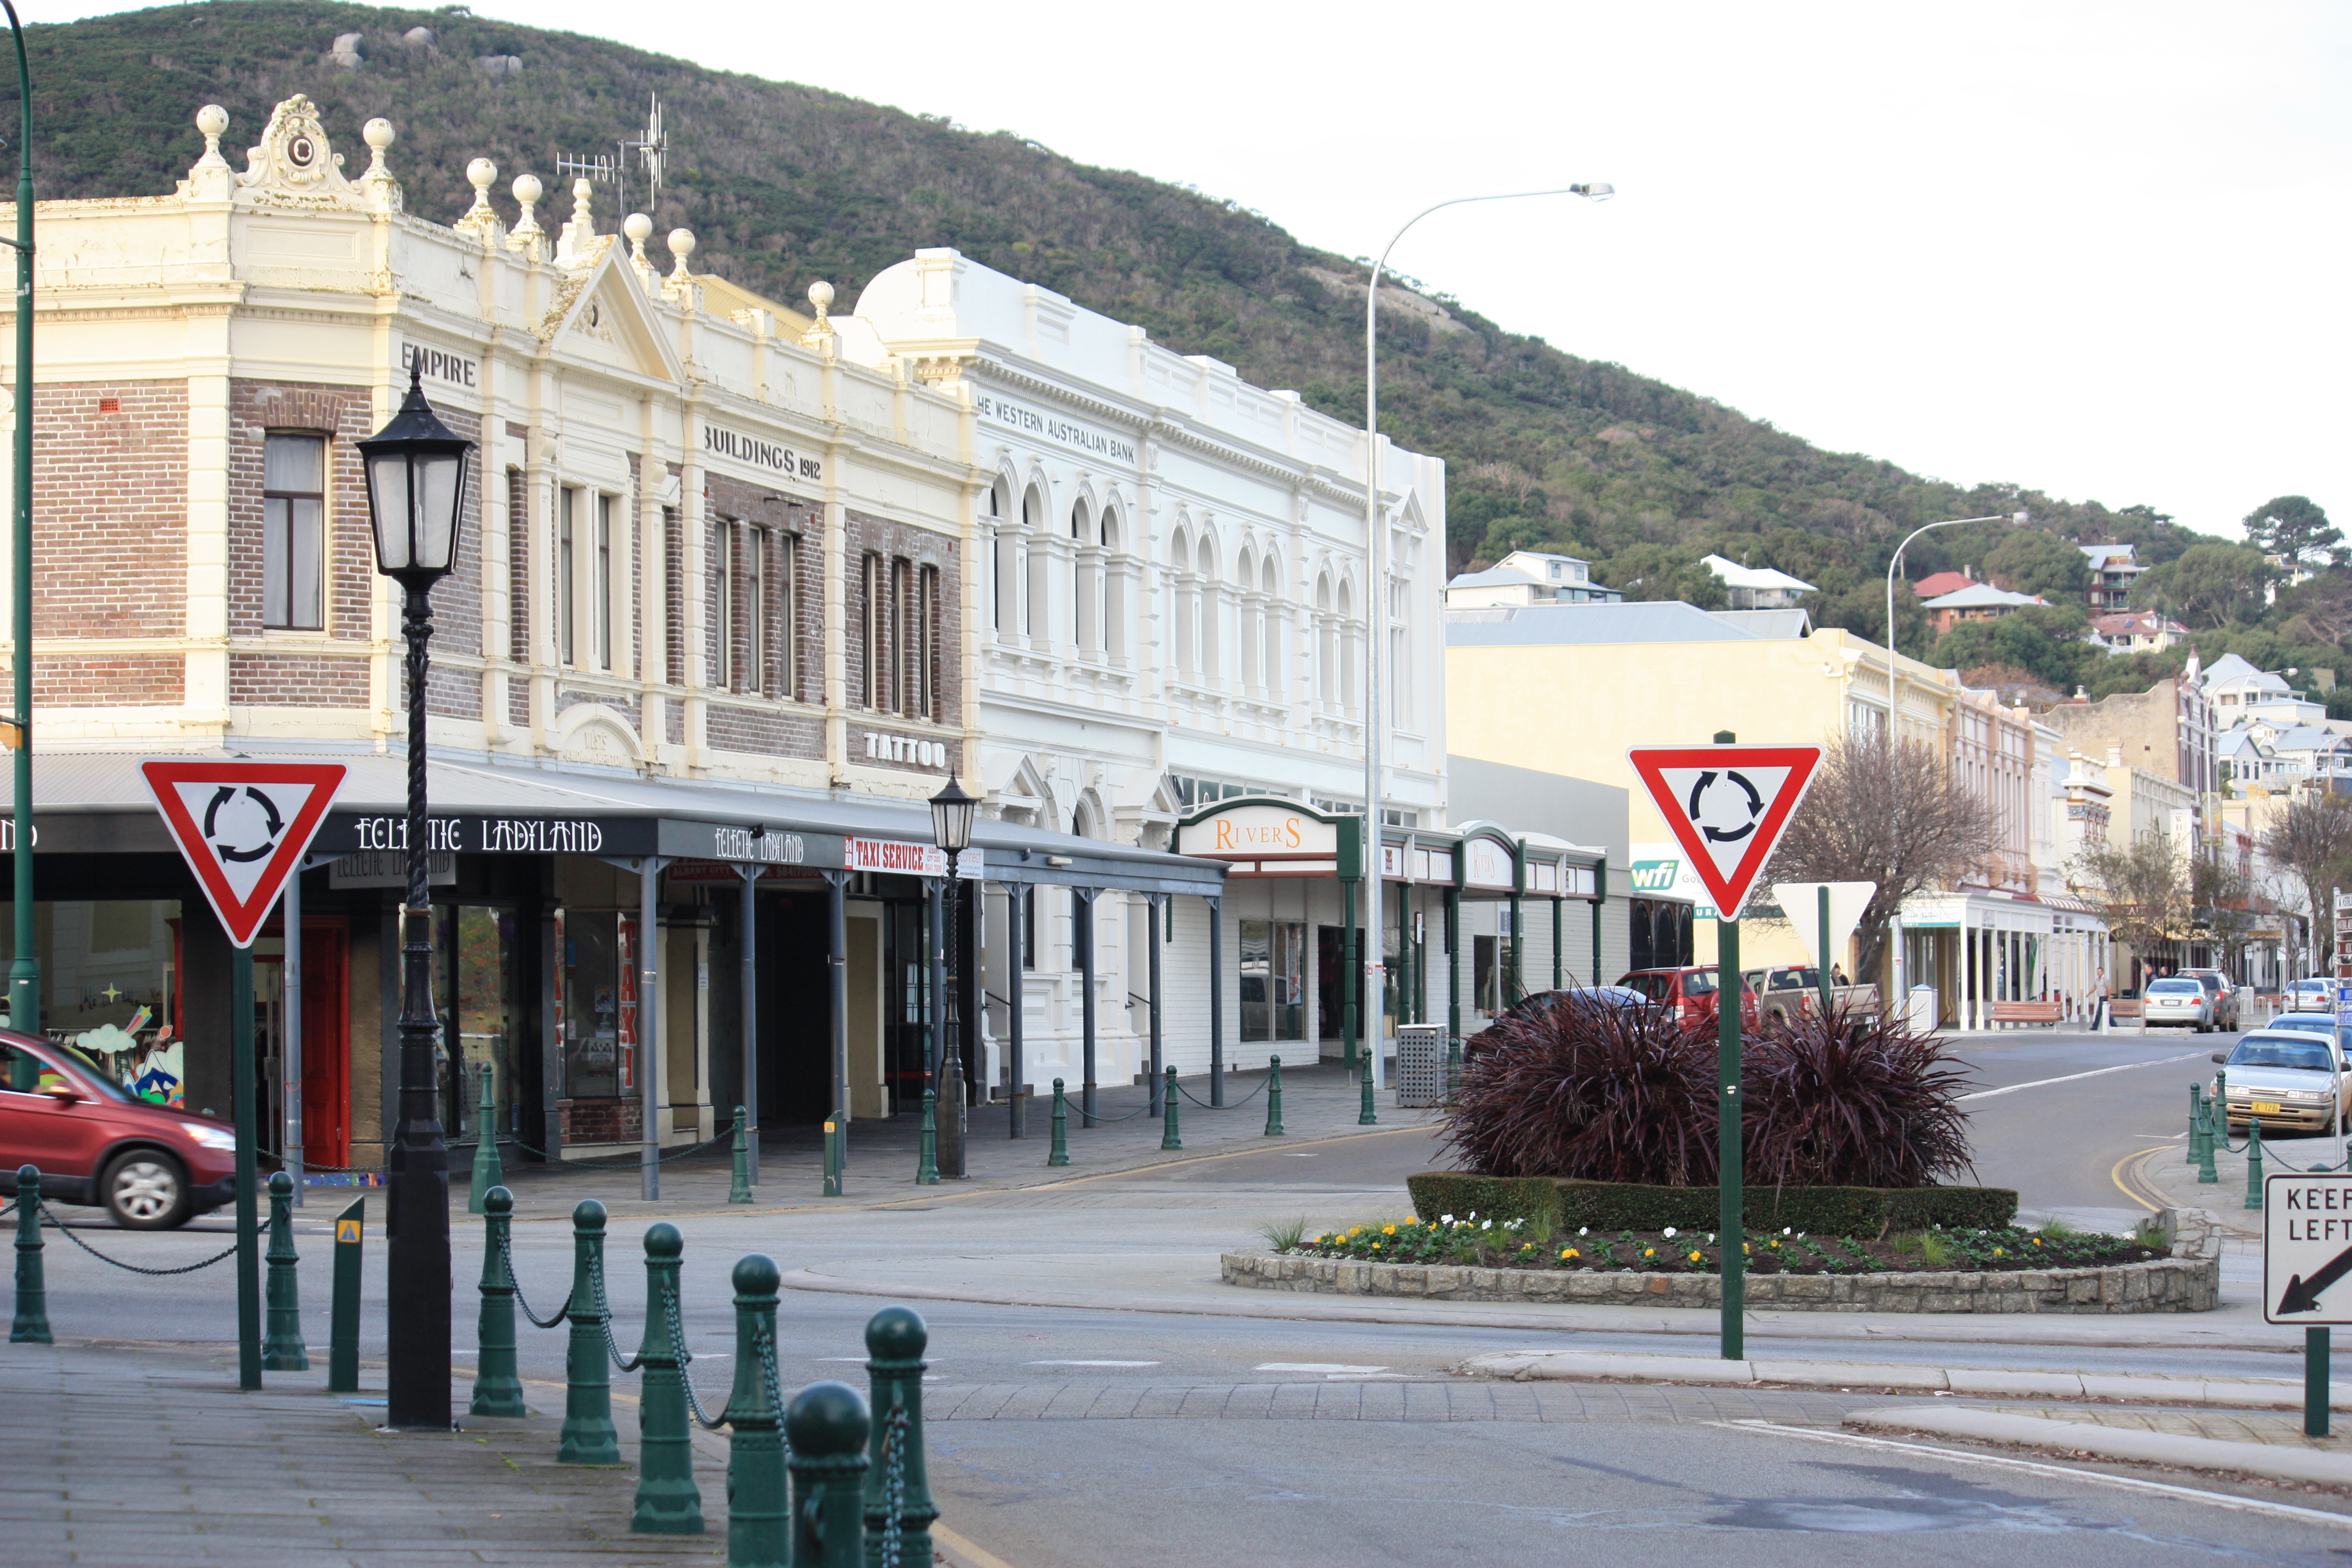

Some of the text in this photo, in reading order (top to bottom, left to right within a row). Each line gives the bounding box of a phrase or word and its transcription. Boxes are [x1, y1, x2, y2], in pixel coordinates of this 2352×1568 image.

[402, 342, 476, 387] EMPIRE
[977, 395, 1135, 464] HE WESTERN AUSTRALIAN BANK
[705, 426, 821, 480] BUILDINGS 1912
[864, 732, 945, 769] TATTOO
[481, 819, 603, 852] LADYLAND
[714, 827, 804, 863] ECLECTIC LADYLAND
[845, 839, 852, 852] 24
[672, 865, 707, 878] ALBANY
[709, 865, 730, 874] CITY
[856, 840, 924, 871] TAXI SERVICE
[956, 850, 981, 863] econnect
[1631, 862, 1675, 888] wfi
[620, 919, 637, 1088] TAXI
[2287, 1188, 2352, 1210] KEEP
[2289, 1219, 2352, 1241] LEFT
